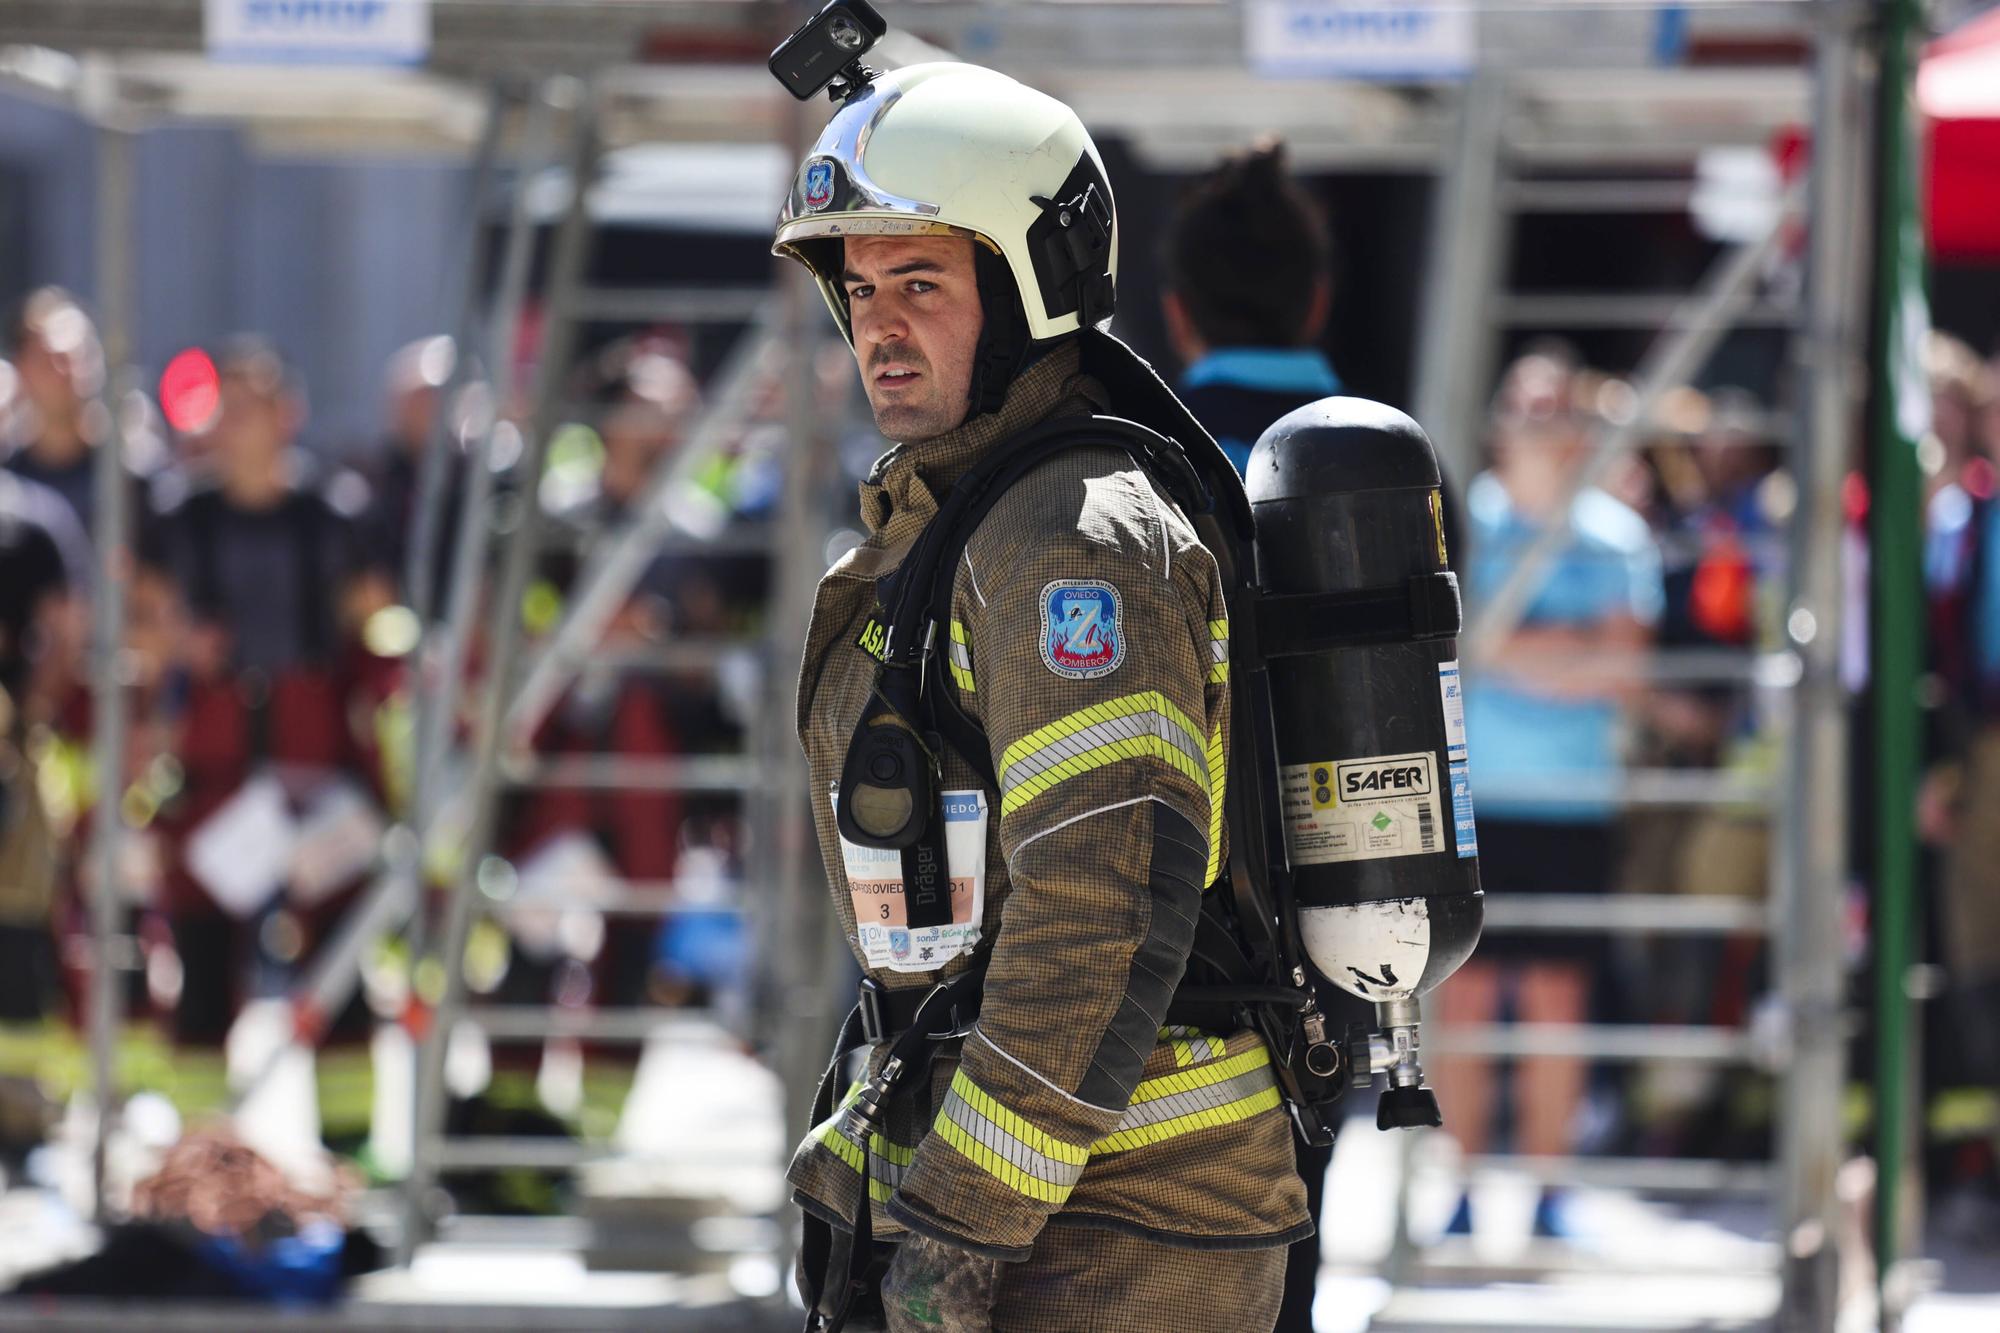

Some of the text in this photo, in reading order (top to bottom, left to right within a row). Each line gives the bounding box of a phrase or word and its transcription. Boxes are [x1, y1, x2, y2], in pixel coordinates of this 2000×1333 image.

[1064, 591, 1100, 599] OVIEDO
[1059, 655, 1109, 668] BOMBEROS
[1346, 766, 1423, 793] SAFER
[916, 845, 938, 905] Dräger
[960, 882, 965, 892] 1
[880, 904, 890, 919] 3
[916, 935, 940, 943] sonar
